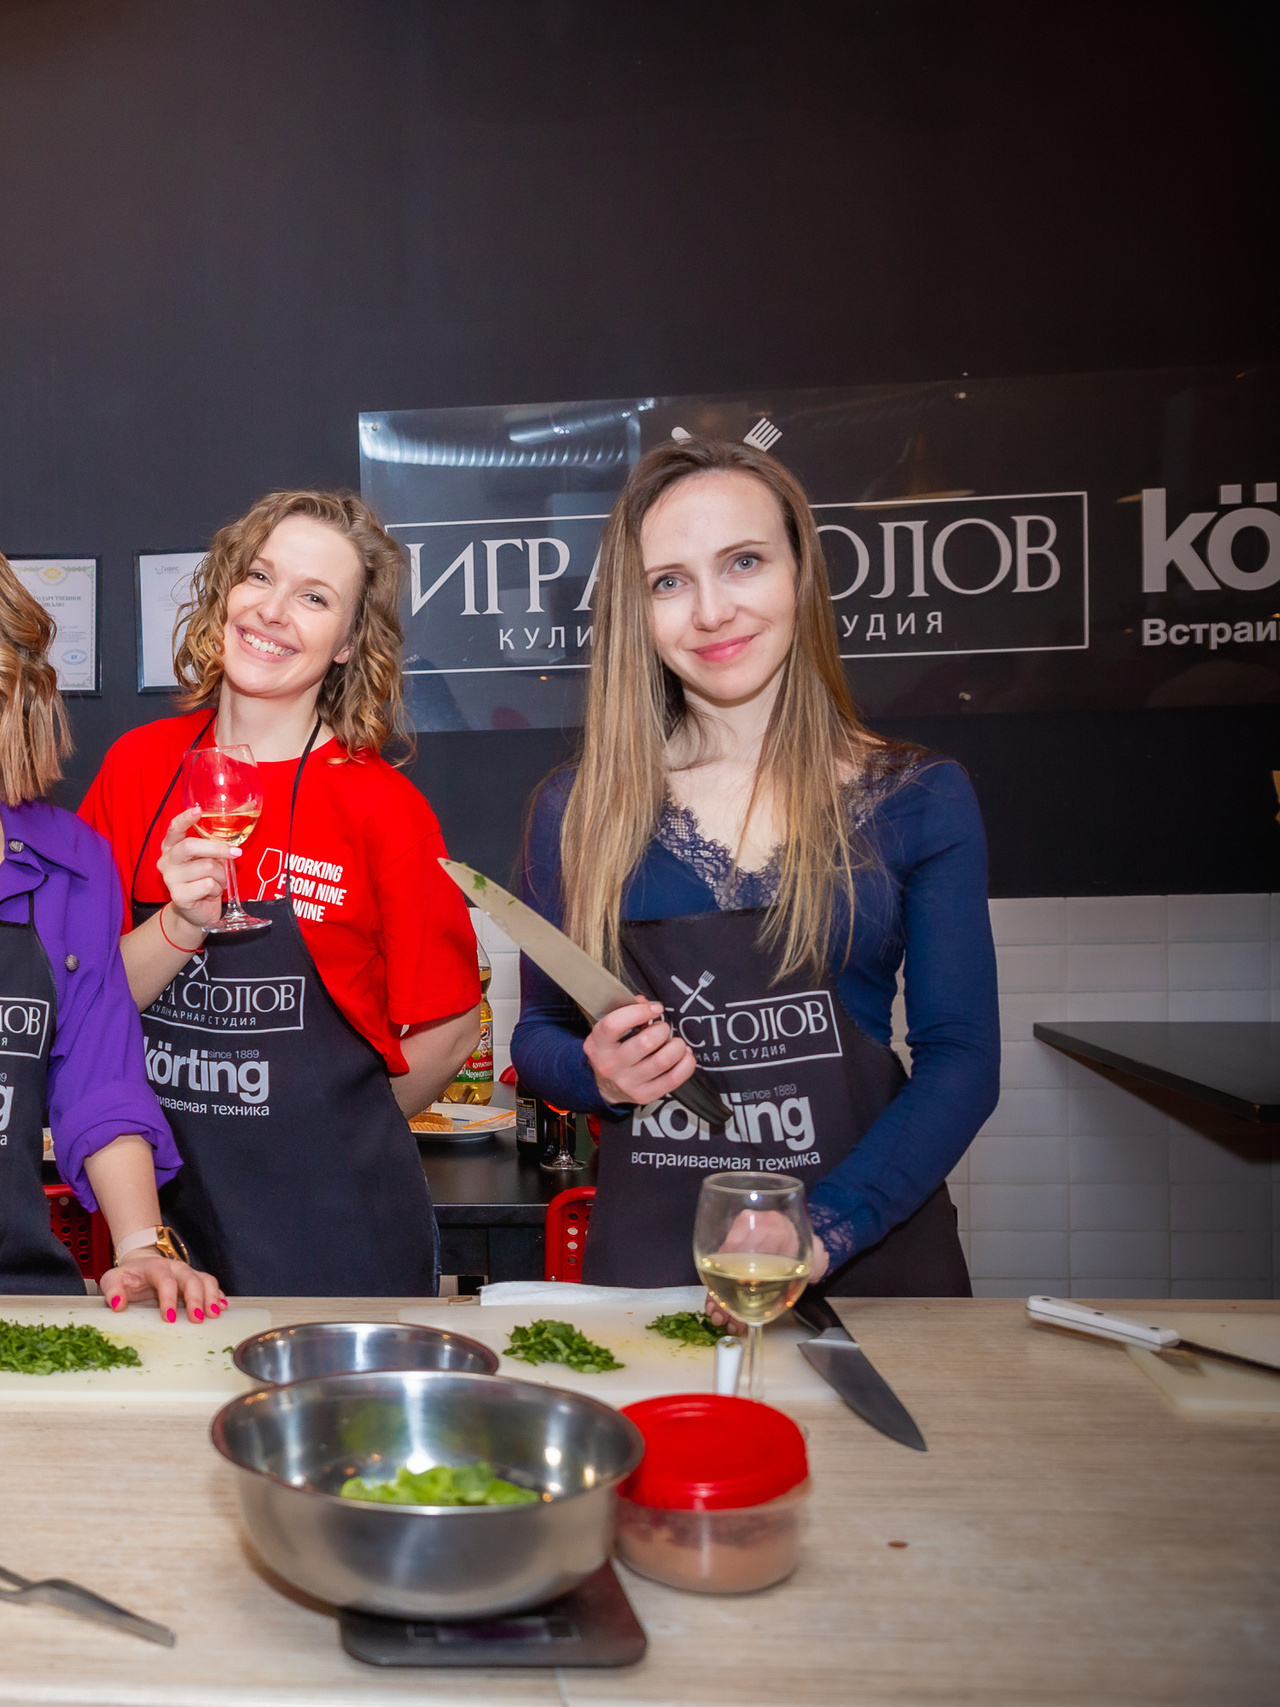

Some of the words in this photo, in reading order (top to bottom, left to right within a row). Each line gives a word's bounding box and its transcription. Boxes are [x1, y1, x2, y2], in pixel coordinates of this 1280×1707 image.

[816, 514, 1061, 601] ОЛОВ
[841, 611, 944, 641] УДИЯ
[1142, 618, 1280, 650] Встраи
[284, 852, 343, 882] WORKING
[277, 873, 316, 898] FROM
[315, 883, 347, 906] NINE
[293, 898, 325, 922] WINE
[183, 981, 296, 1014] СТОЛОВ
[208, 1016, 257, 1027] СТУДИЯ
[679, 1001, 828, 1048] СТОЛОВ
[208, 1049, 232, 1059] since
[235, 1049, 260, 1059] 1889
[729, 1043, 787, 1061] СТУДИЯ
[143, 1036, 269, 1104] körting
[155, 1095, 207, 1114] иваемая
[211, 1103, 270, 1117] техника
[742, 1089, 772, 1101] since
[773, 1083, 797, 1097] 1889
[631, 1151, 751, 1170] встраиваемая
[757, 1151, 821, 1171] техника
